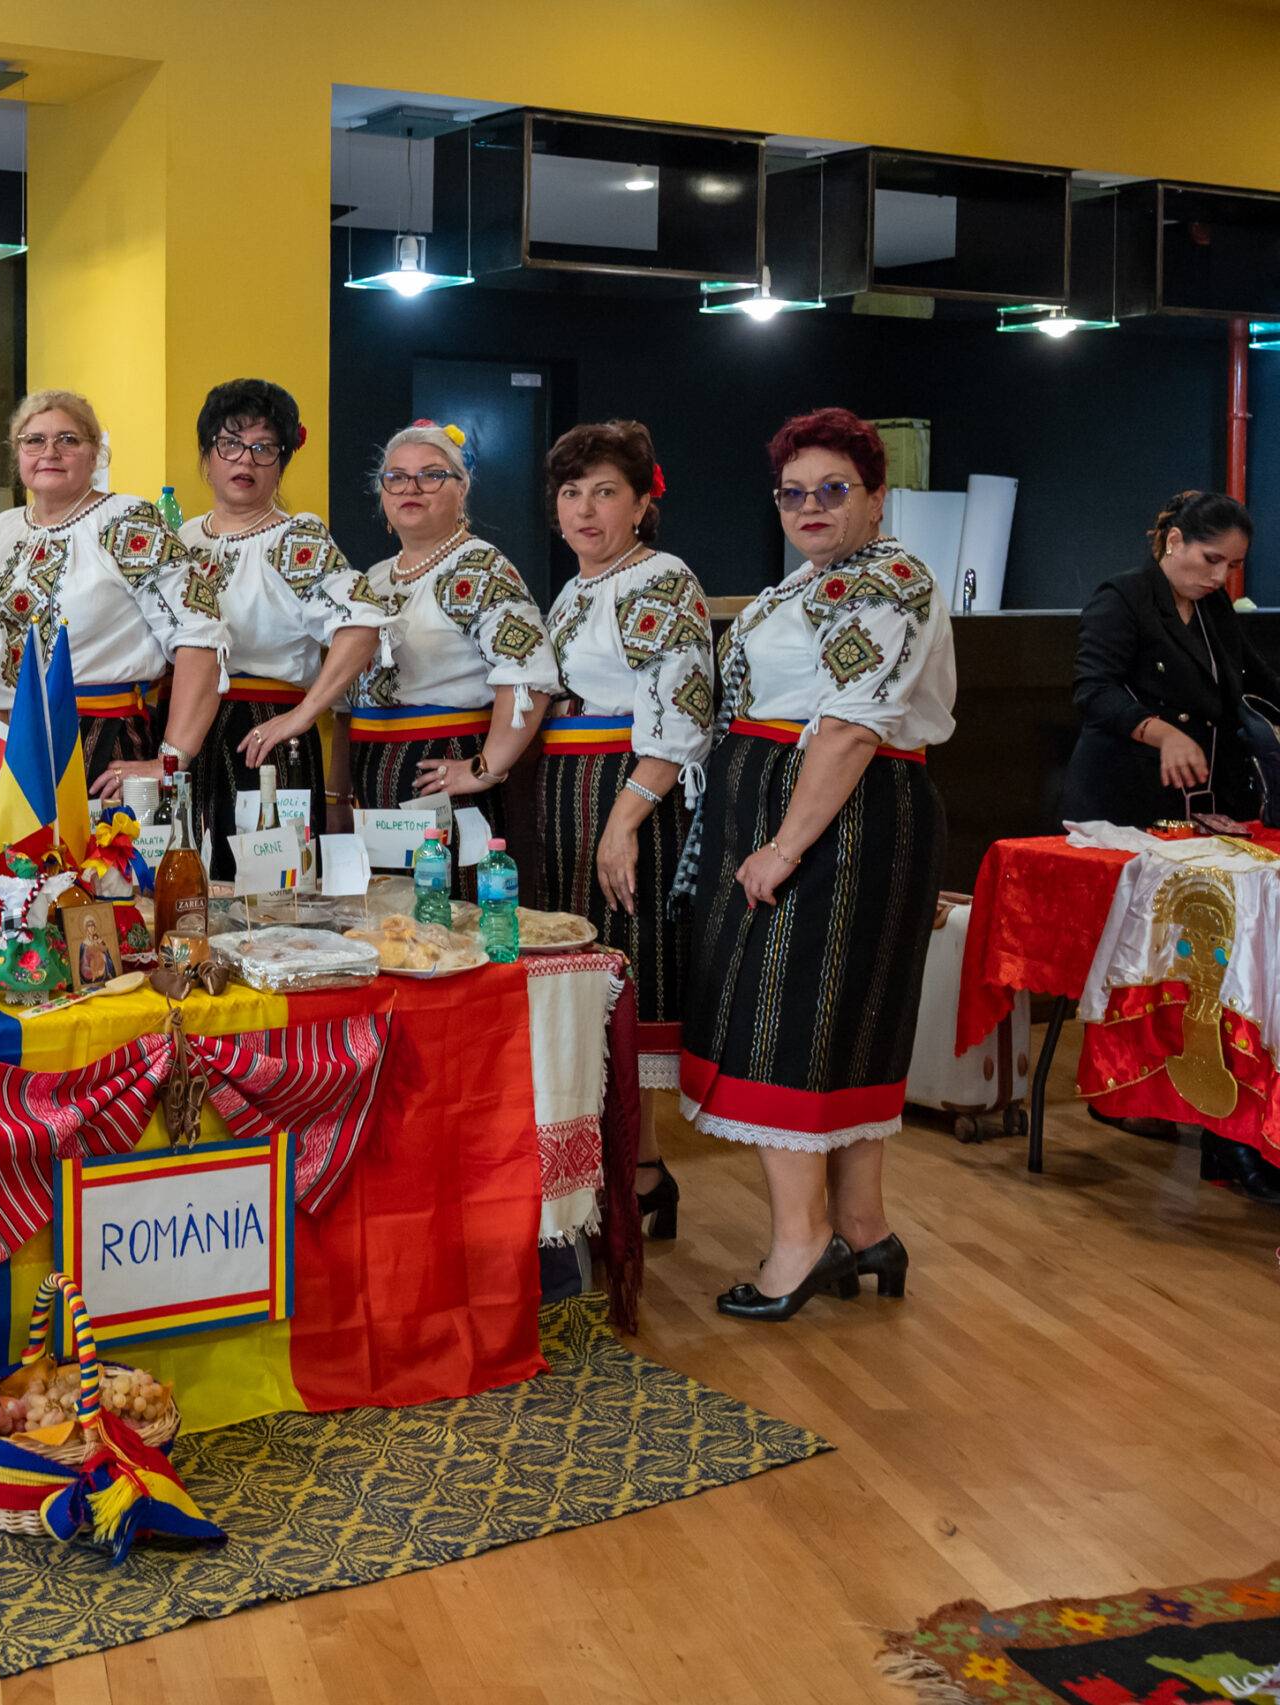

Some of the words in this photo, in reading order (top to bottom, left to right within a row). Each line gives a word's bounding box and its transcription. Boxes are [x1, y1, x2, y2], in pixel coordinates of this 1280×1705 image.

[253, 841, 283, 856] CARNE
[178, 900, 204, 909] ZAREA
[101, 1201, 264, 1271] ROMÂNIA
